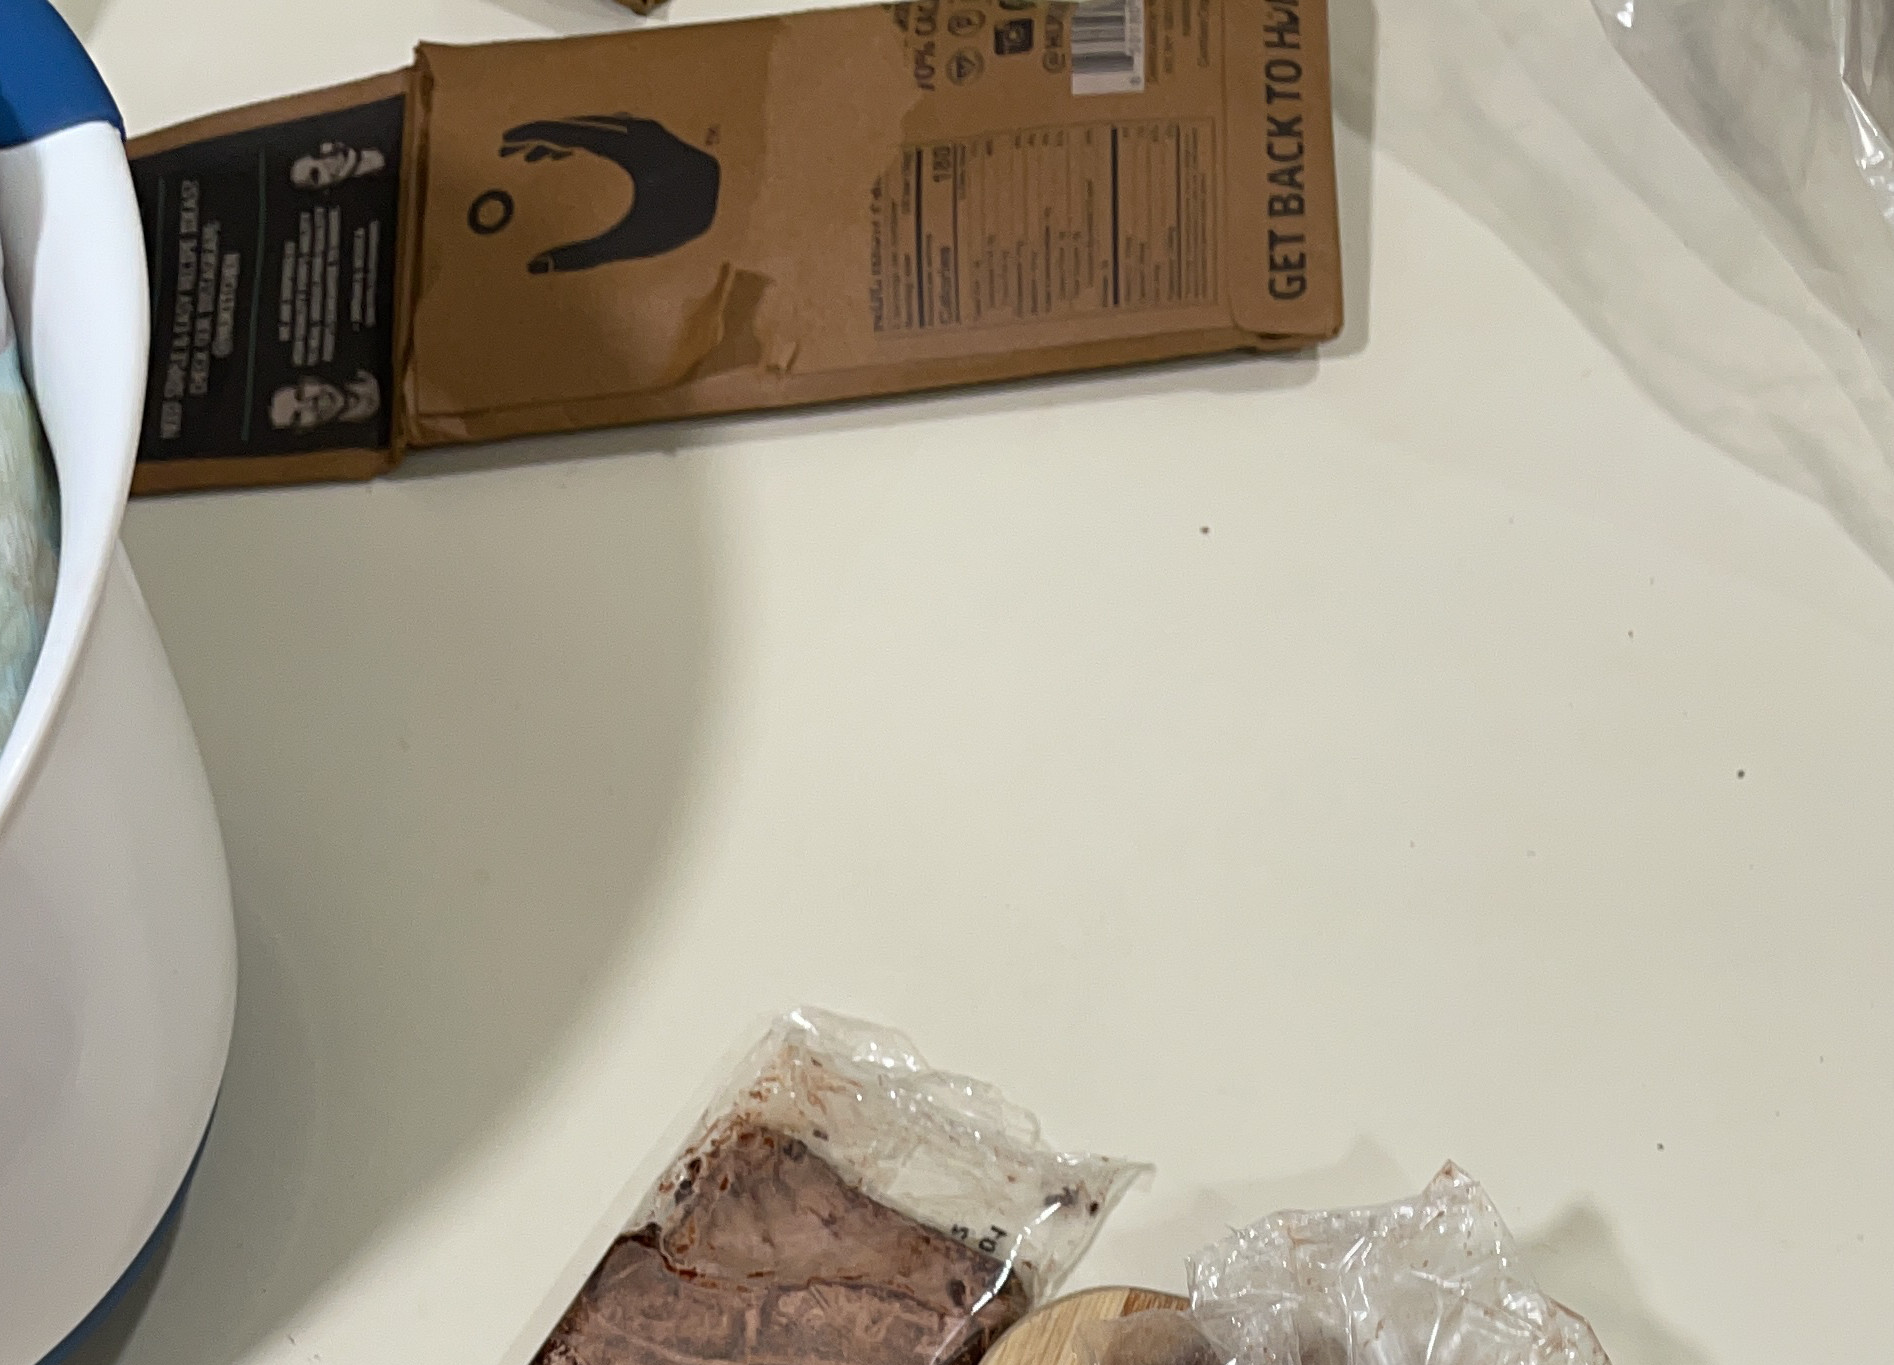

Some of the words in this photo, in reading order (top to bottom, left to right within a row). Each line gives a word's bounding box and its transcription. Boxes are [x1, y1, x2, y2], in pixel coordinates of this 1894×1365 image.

[1264, 59, 1302, 104] TO
[1266, 116, 1305, 217] BACK
[1267, 229, 1307, 300] GET
